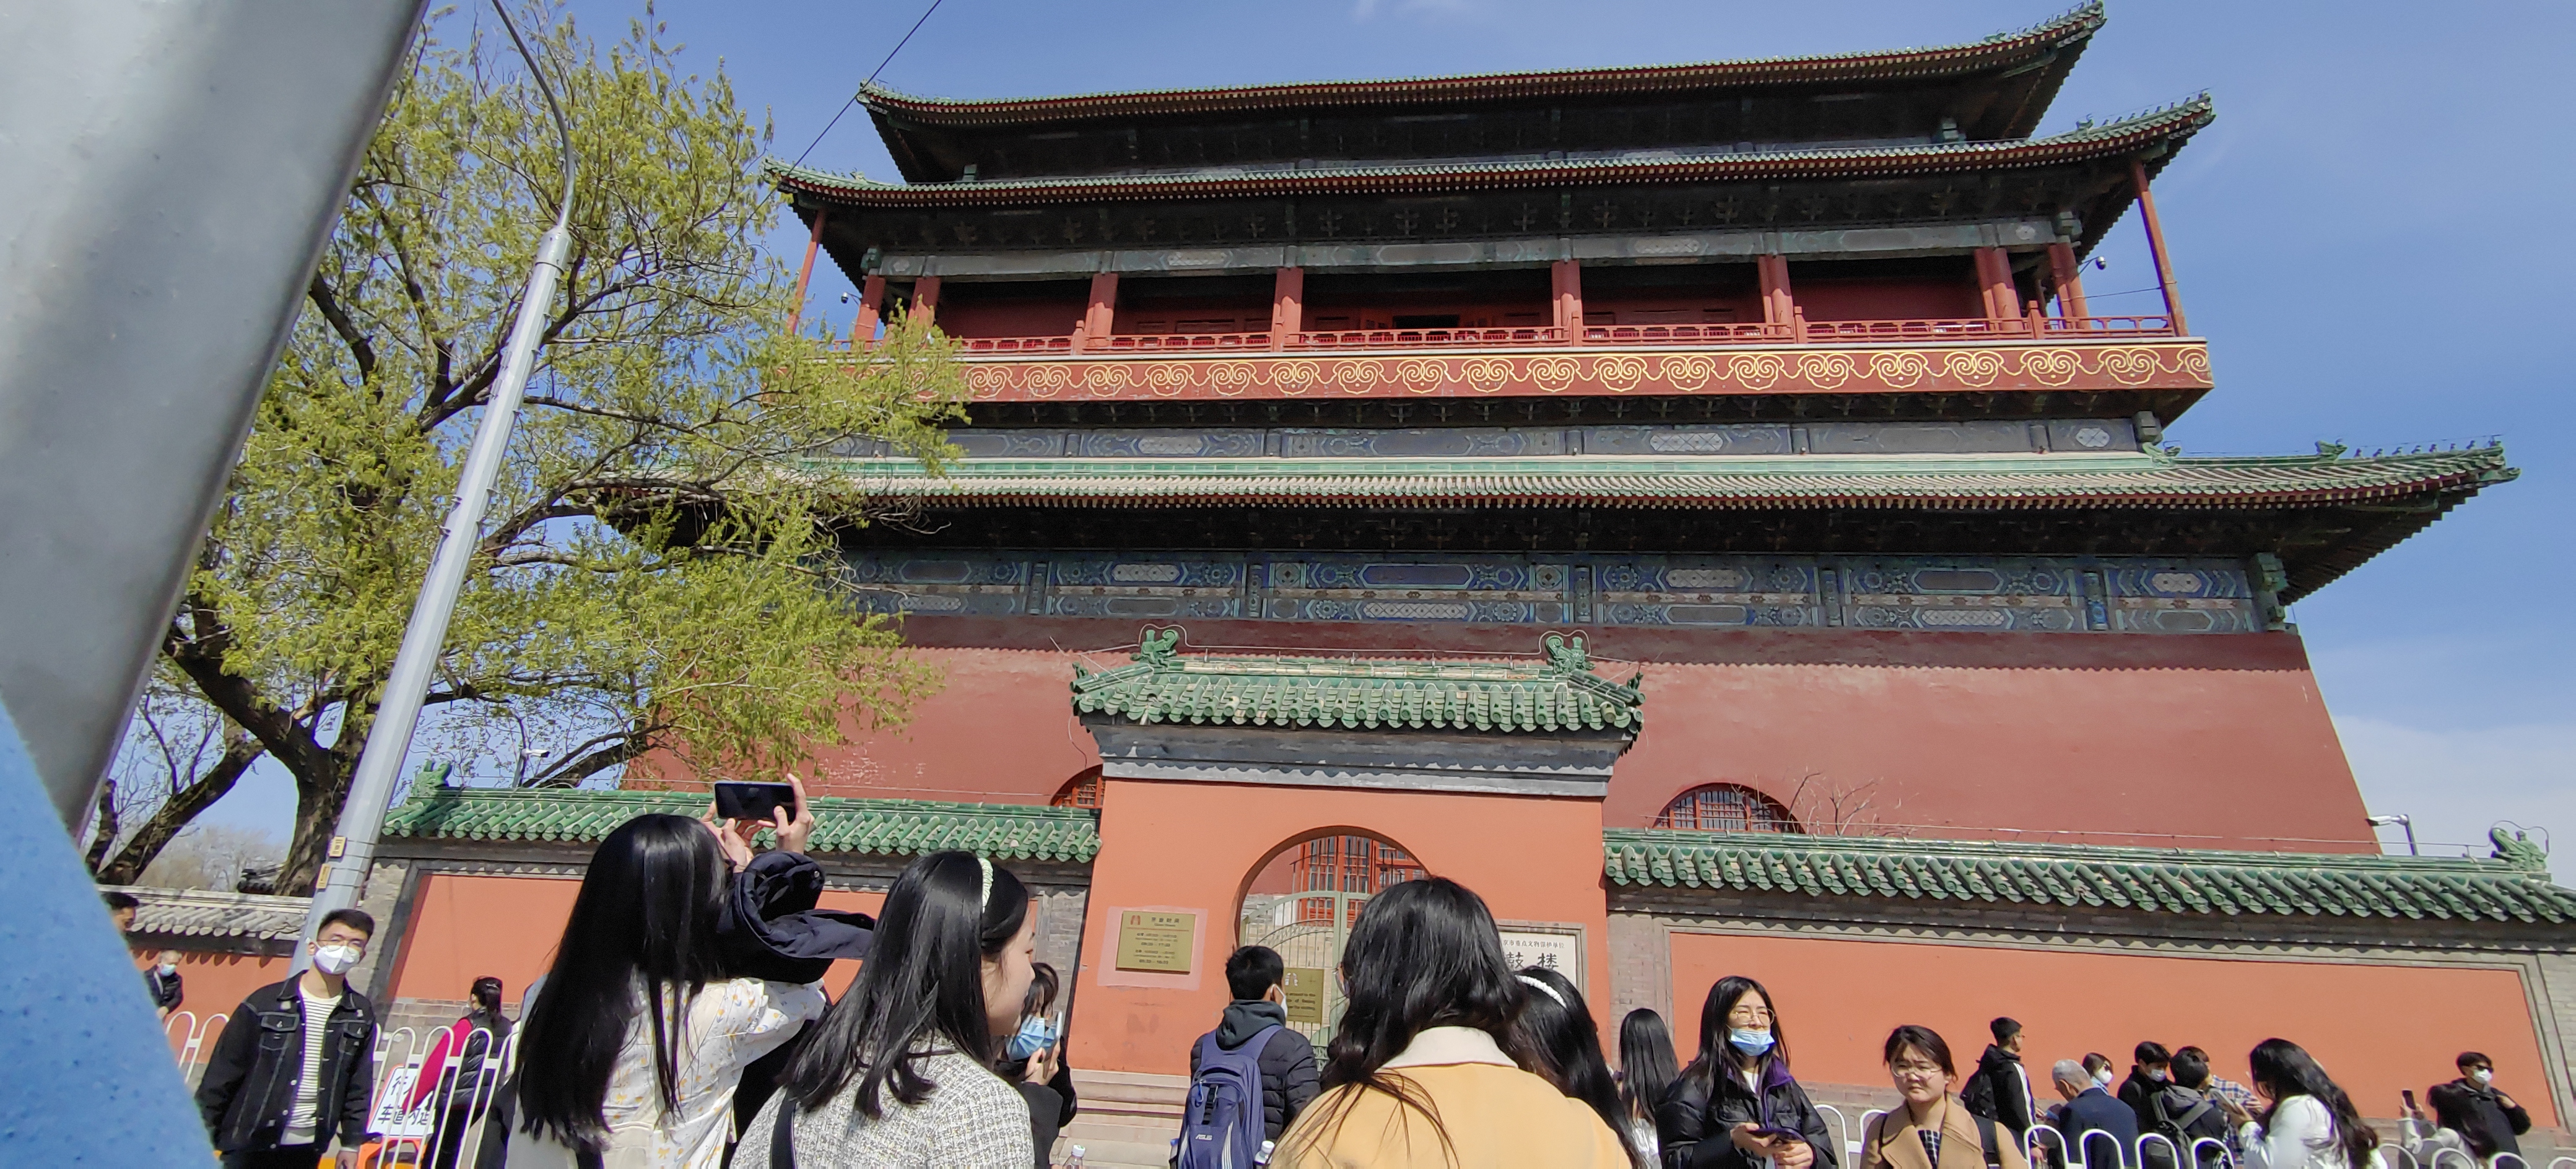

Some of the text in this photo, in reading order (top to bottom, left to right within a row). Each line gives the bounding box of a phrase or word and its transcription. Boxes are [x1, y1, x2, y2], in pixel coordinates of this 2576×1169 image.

[1503, 939, 1565, 949] 京市重点文物保护单位
